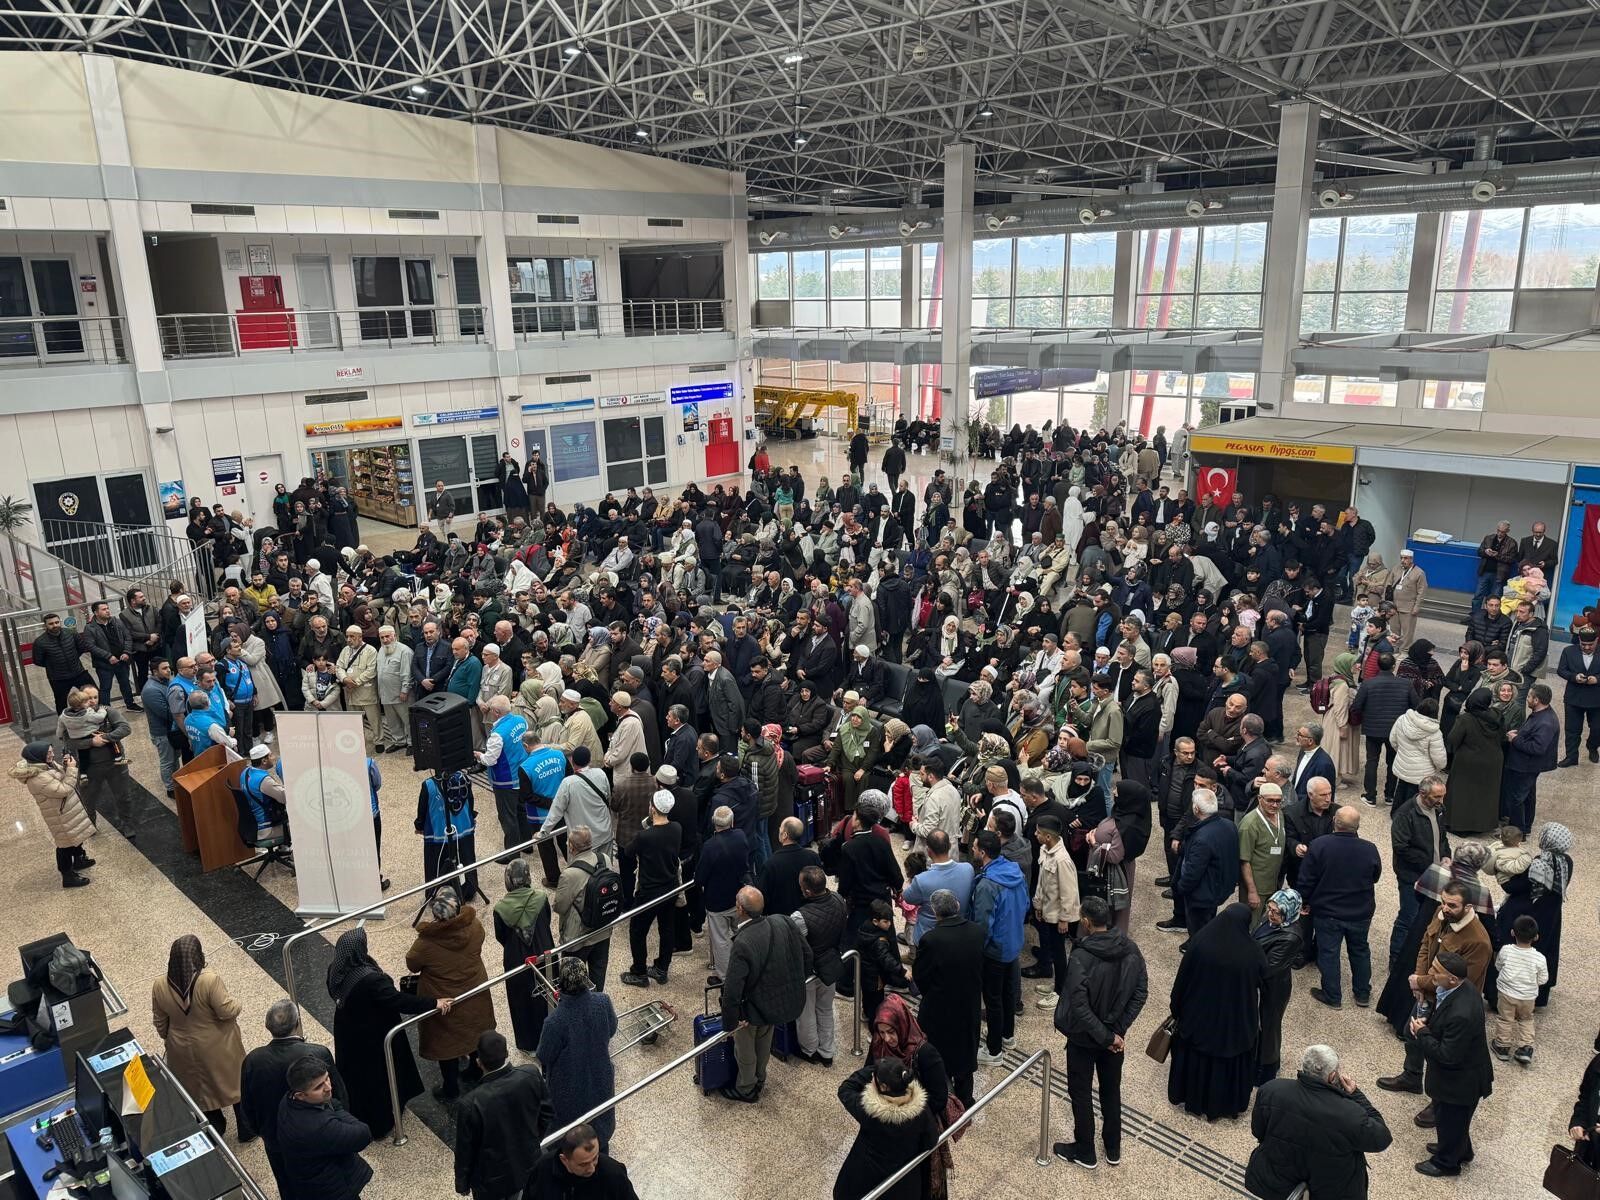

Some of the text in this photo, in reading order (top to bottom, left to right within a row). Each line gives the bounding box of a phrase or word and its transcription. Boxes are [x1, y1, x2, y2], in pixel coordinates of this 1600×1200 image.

[336, 367, 363, 377] REKLAM
[1225, 442, 1265, 453] PEGASUS
[1270, 444, 1316, 457] flypgs.com
[534, 757, 561, 774] DİYANET
[538, 765, 562, 779] GÖREVLİ
